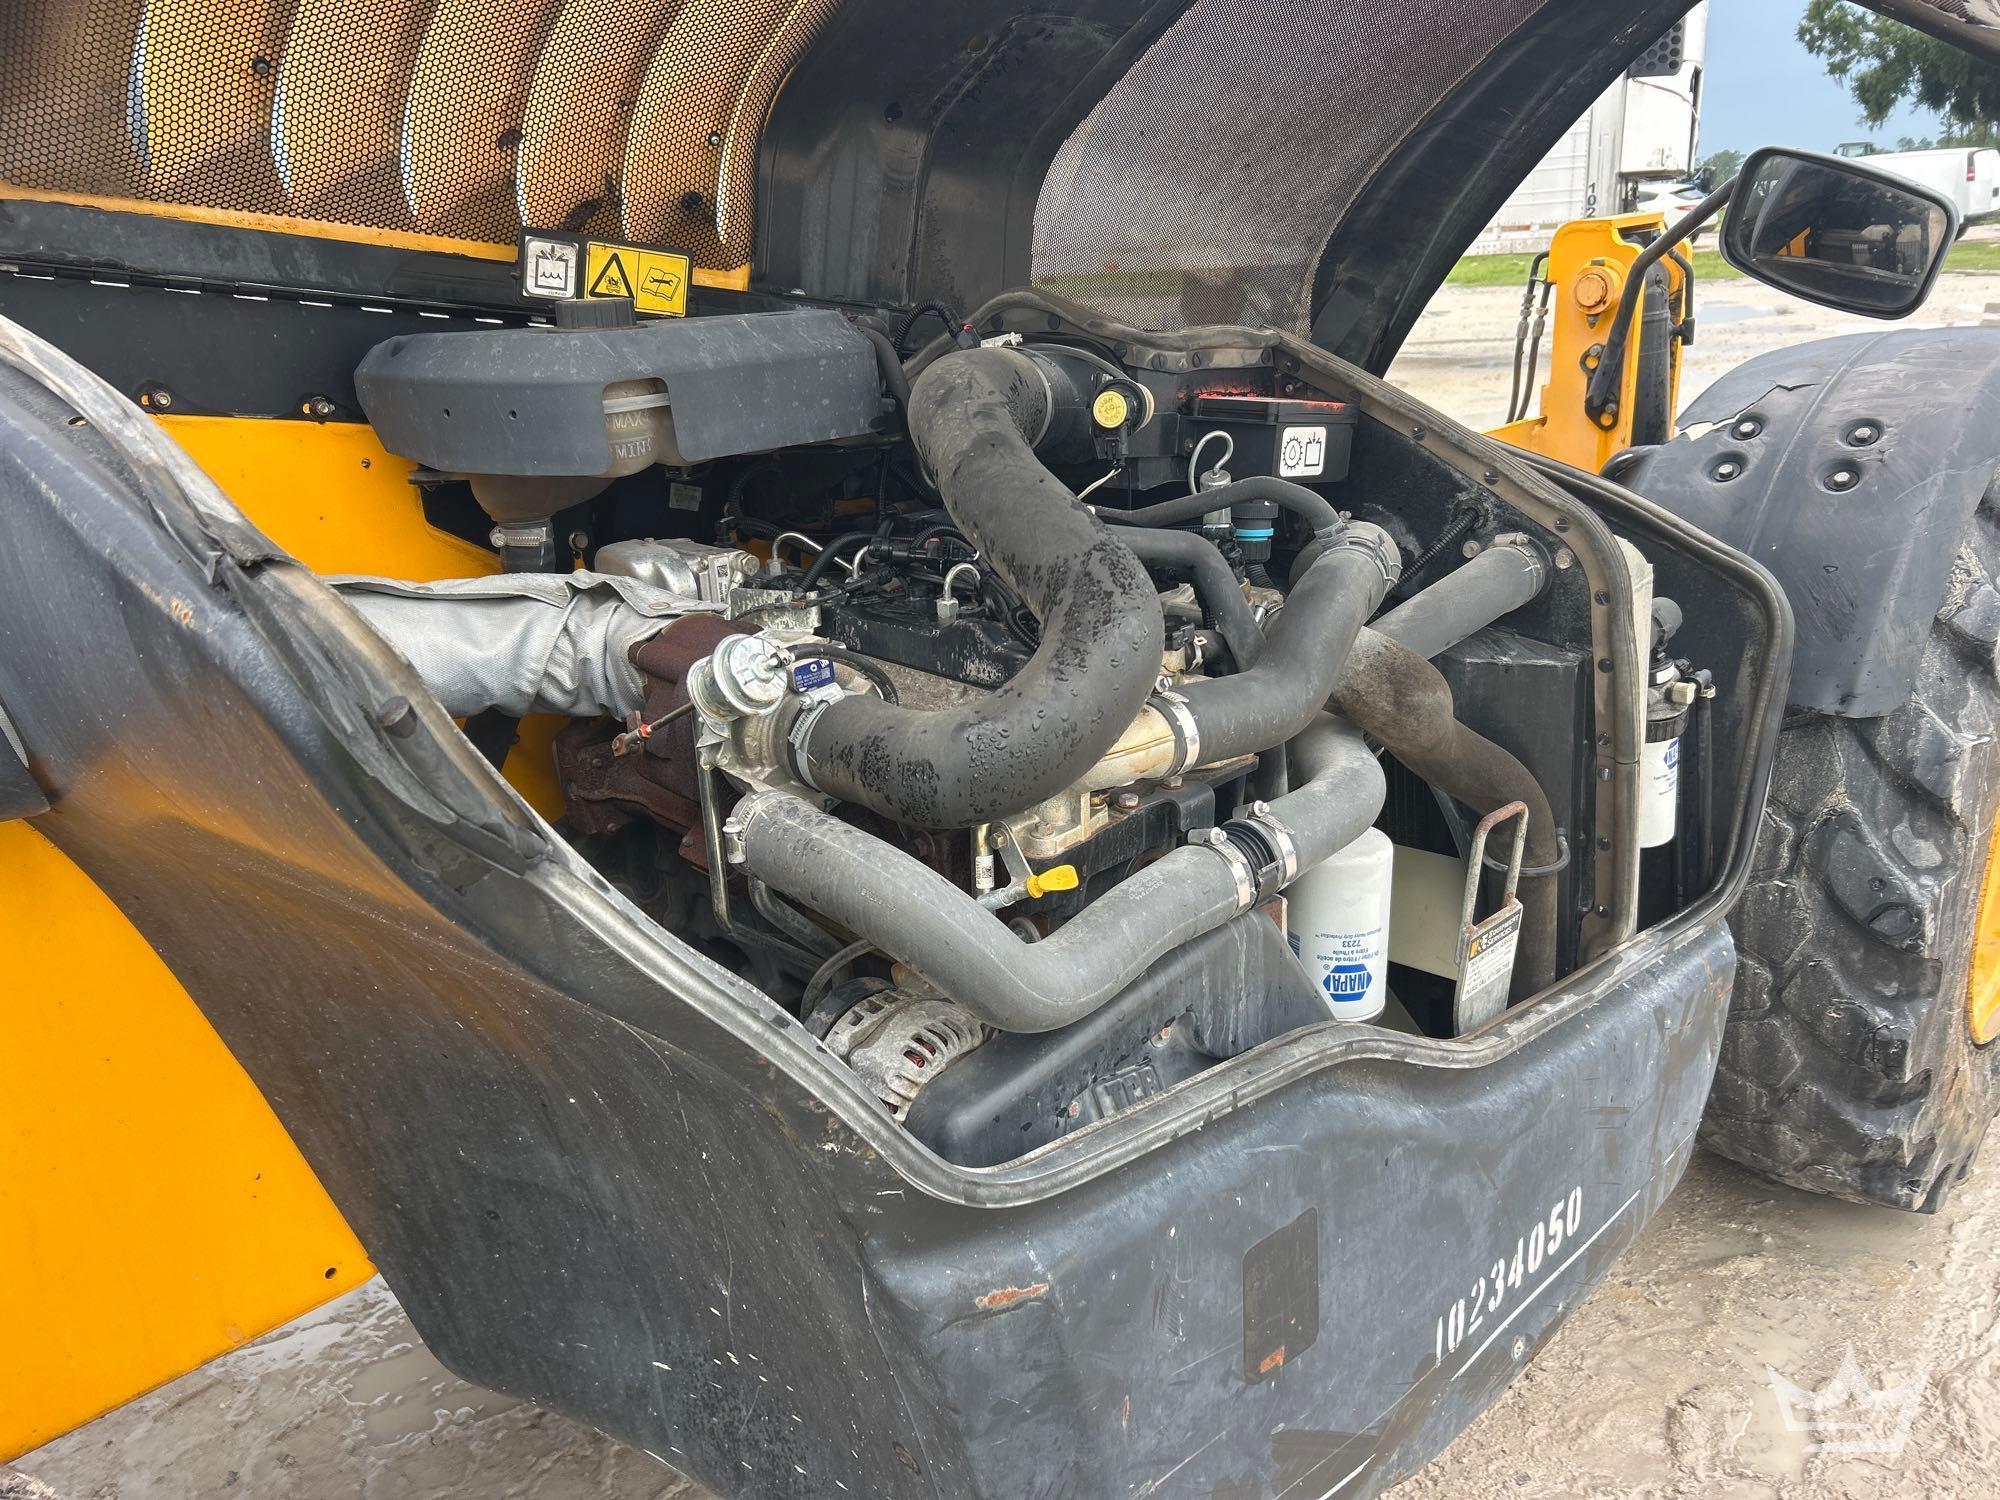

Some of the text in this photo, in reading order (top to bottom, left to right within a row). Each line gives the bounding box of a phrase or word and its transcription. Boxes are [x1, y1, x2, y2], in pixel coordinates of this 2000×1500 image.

[1585, 182, 1597, 218] 102
[1342, 940, 1361, 948] 7233
[1332, 973, 1366, 993] NAPA
[1435, 1186, 1582, 1368] 10234050
